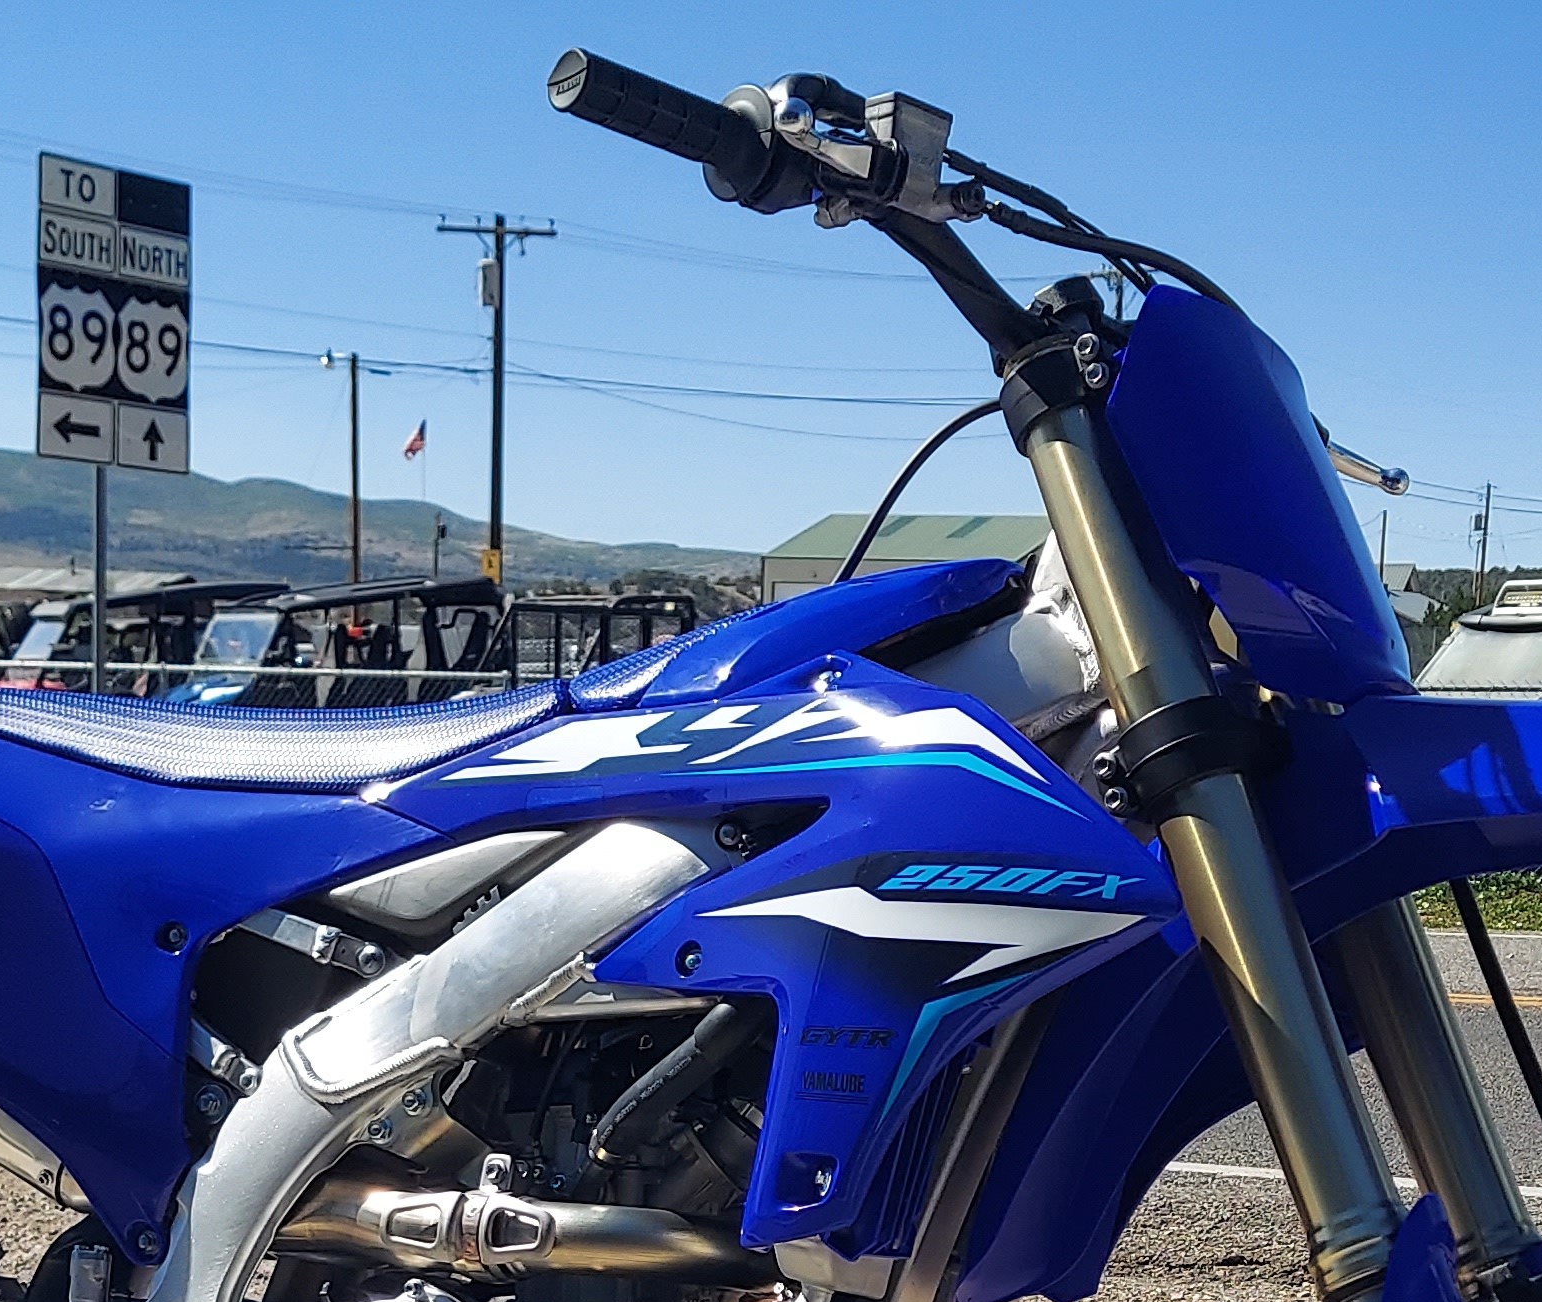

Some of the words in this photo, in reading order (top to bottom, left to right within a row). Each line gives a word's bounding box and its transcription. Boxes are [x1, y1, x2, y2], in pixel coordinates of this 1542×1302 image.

[60, 168, 96, 203] TO
[43, 219, 111, 264] SOUTH
[122, 236, 188, 279] NORTH
[48, 303, 107, 364] 89
[125, 320, 182, 377] 89
[877, 864, 1147, 900] 250FX
[799, 1025, 896, 1049] GYTR
[802, 1071, 866, 1094] YAMALUBE
